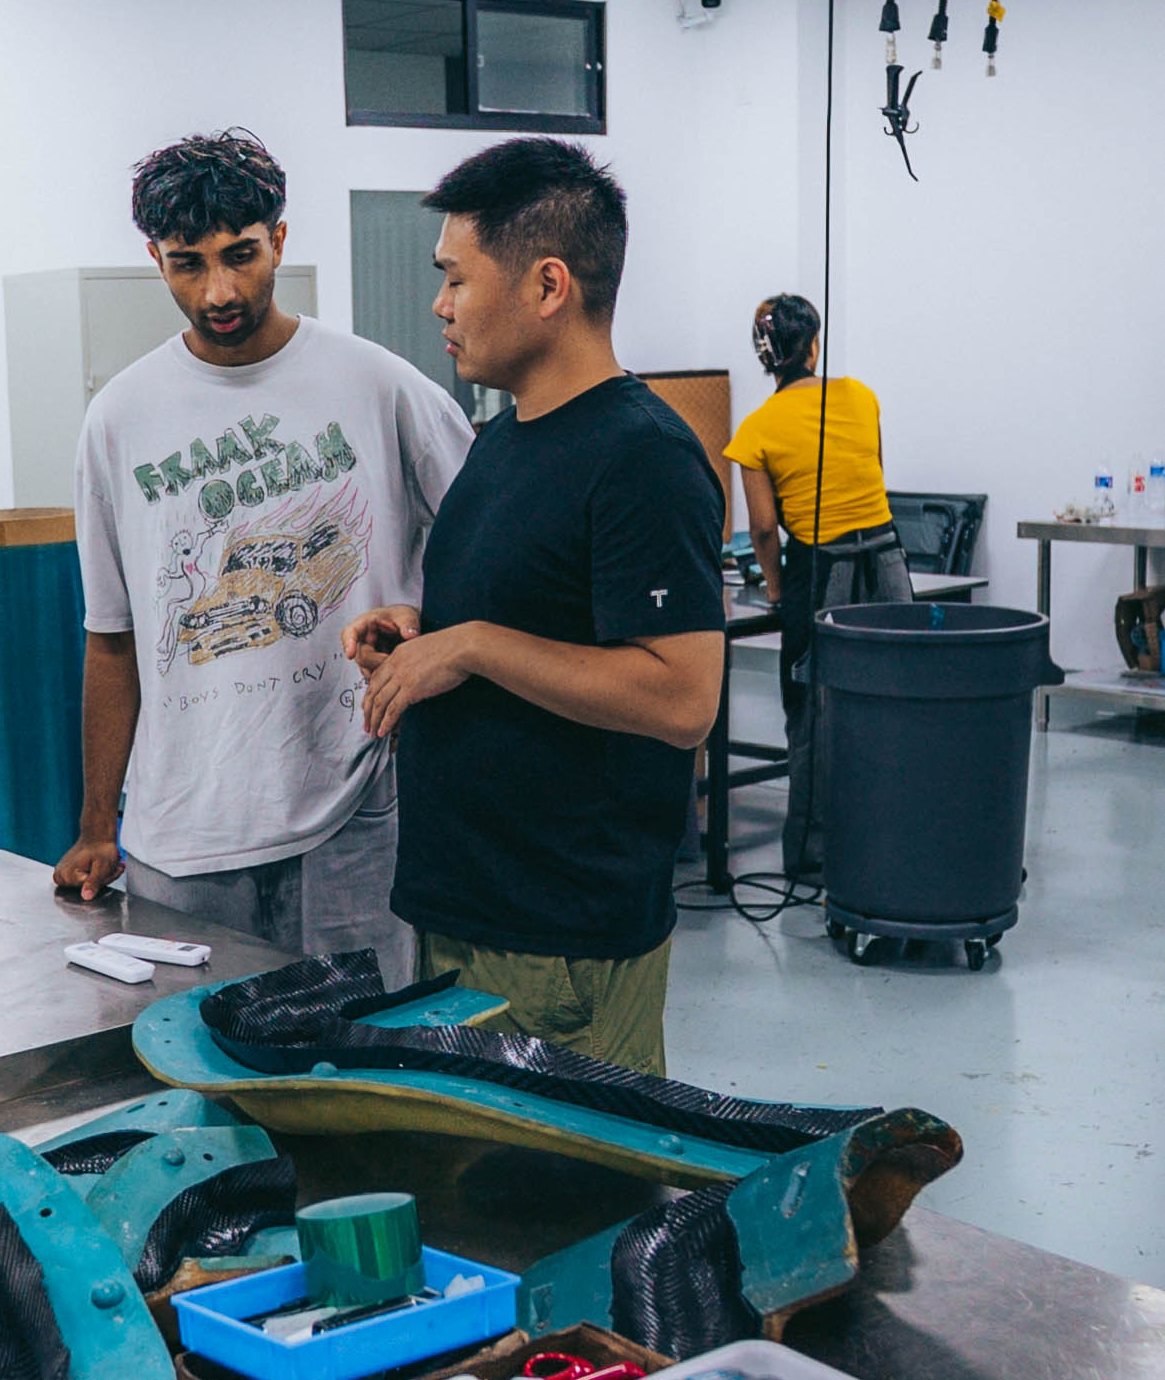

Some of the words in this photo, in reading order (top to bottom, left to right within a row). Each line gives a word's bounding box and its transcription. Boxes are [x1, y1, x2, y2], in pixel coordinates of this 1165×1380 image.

[133, 413, 286, 505] FRANK
[198, 420, 357, 520] OCEAN
[650, 589, 668, 608] T
